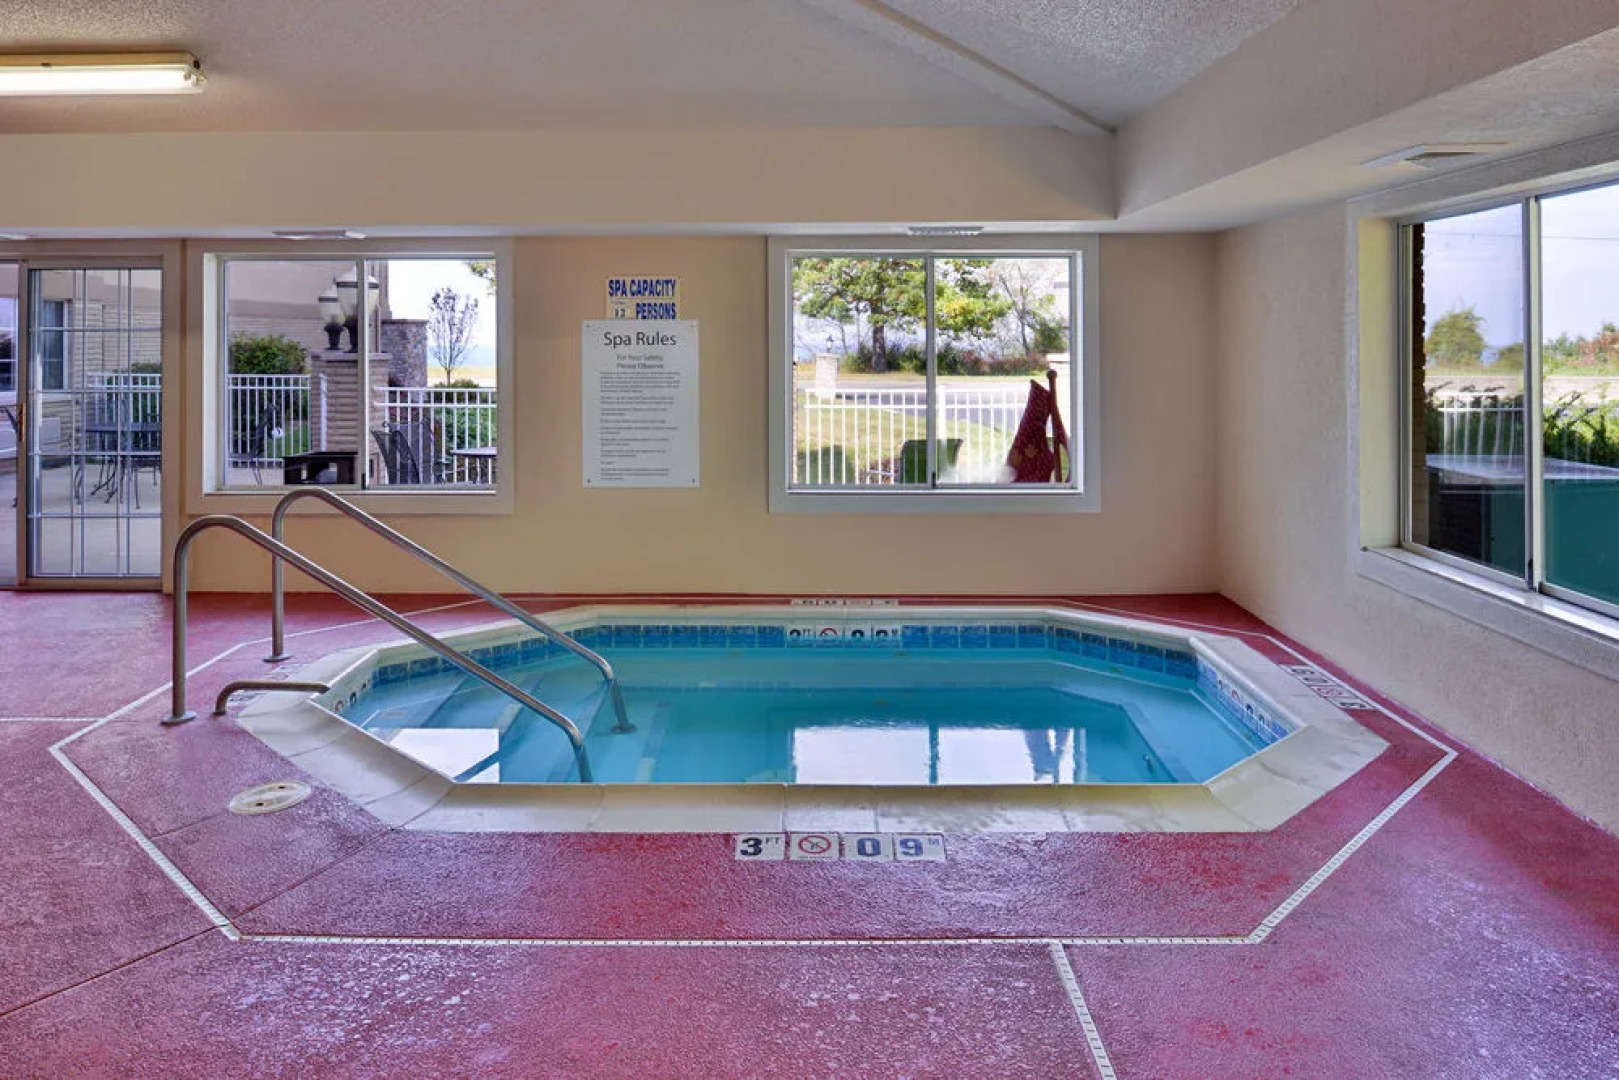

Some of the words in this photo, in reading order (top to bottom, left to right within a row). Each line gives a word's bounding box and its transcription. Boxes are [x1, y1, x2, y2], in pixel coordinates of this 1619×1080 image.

[608, 279, 628, 297] SPA
[629, 279, 676, 297] CAPACITY
[635, 302, 676, 320] PERSONS
[603, 331, 632, 349] Spa
[635, 331, 677, 346] Rules
[740, 837, 762, 856] 3
